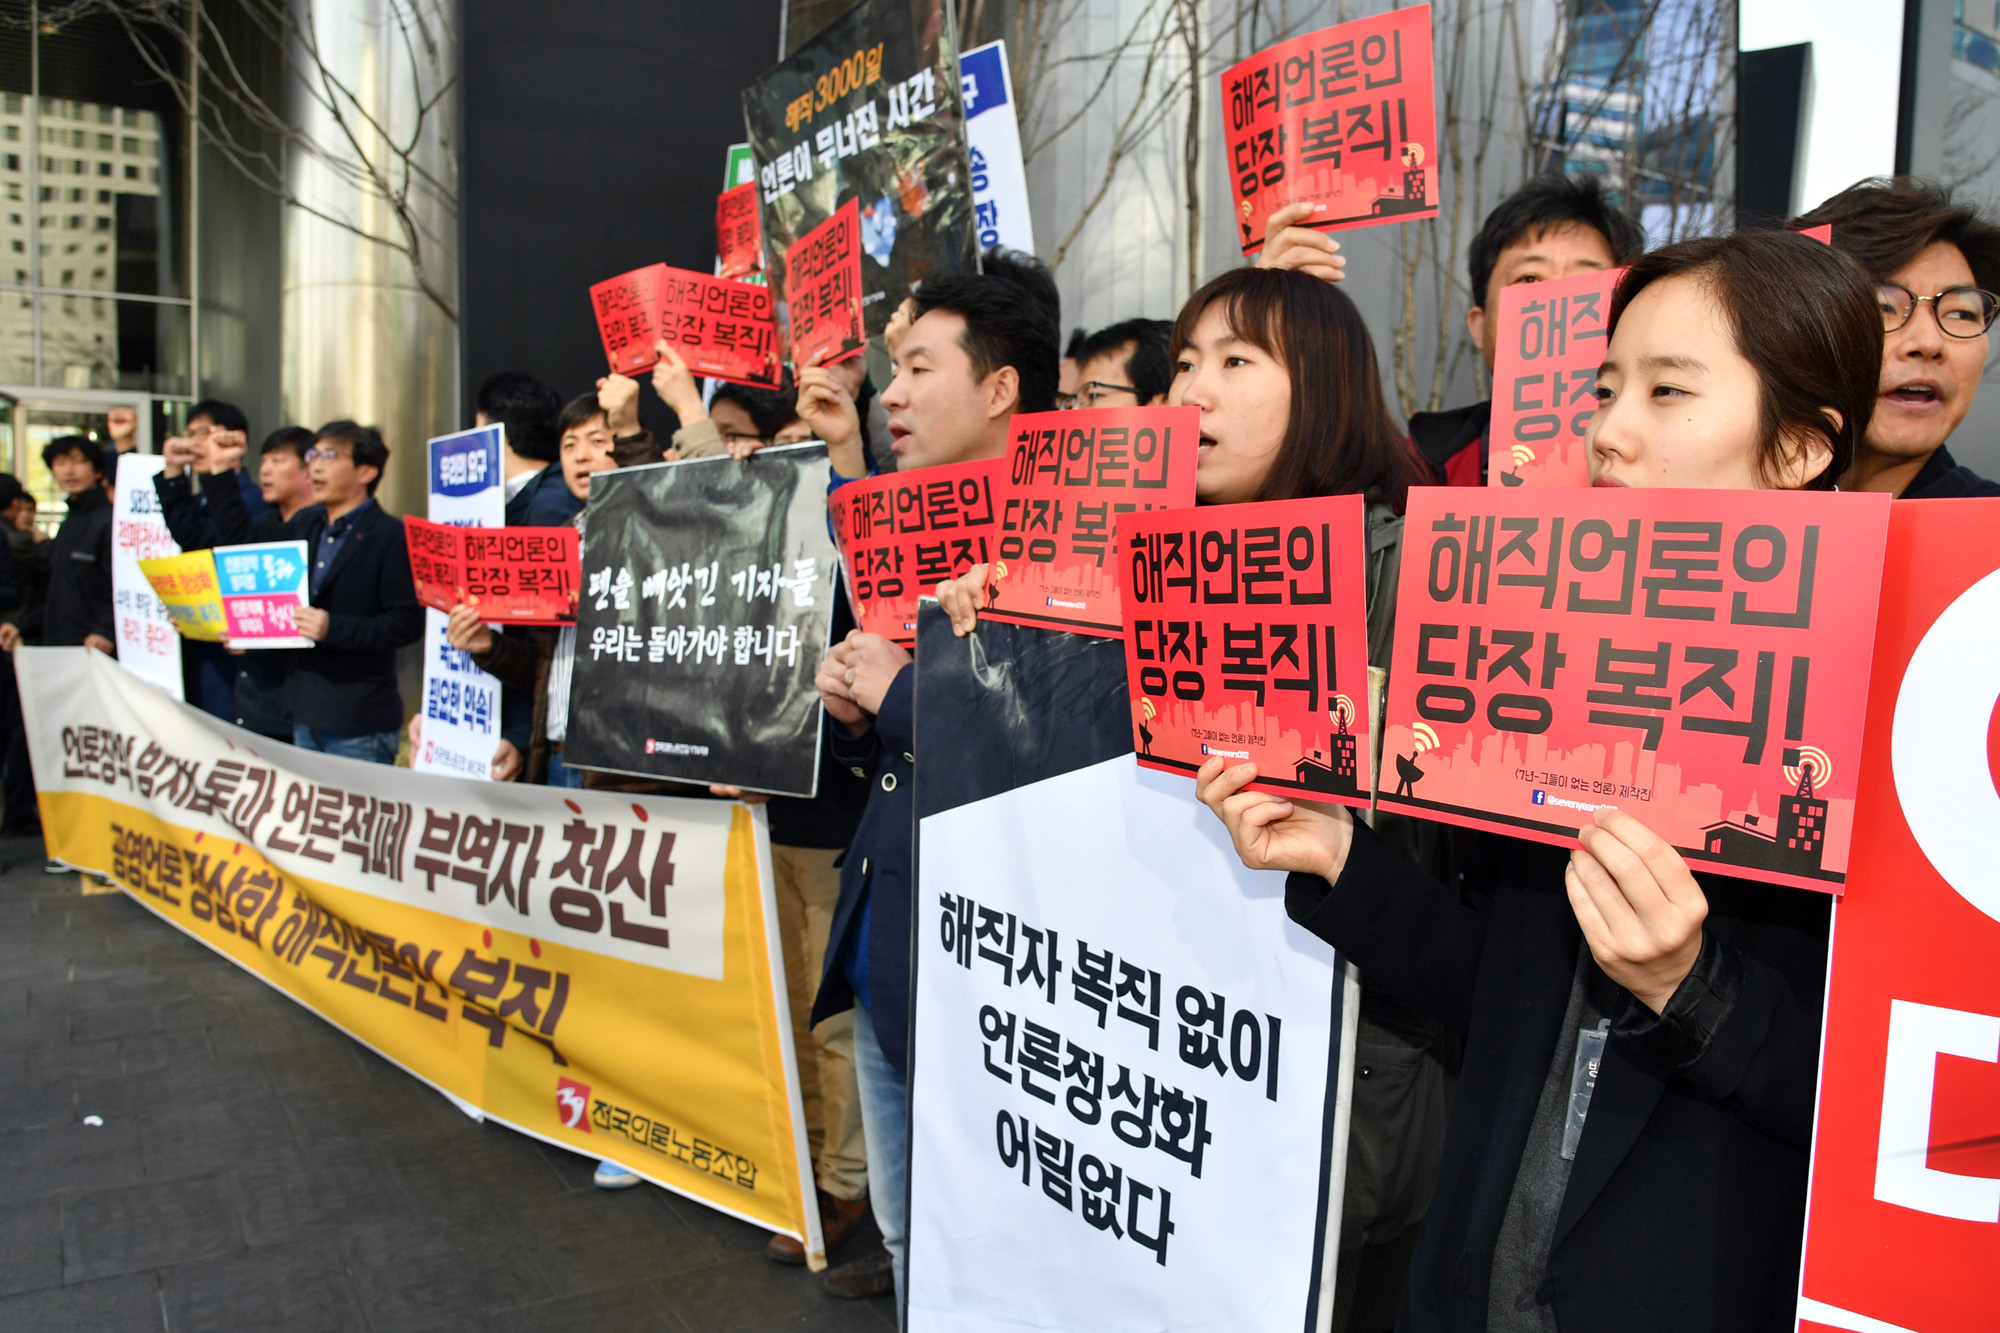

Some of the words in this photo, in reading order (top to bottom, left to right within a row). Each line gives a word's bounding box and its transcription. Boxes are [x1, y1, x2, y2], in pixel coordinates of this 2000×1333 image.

[815, 42, 883, 112] 3000일
[1230, 29, 1403, 131] 해직언론인
[761, 140, 813, 205] 언론이
[815, 99, 880, 170] 무너진
[886, 66, 936, 132] 시간
[1234, 125, 1287, 197] 당장
[1300, 98, 1408, 169] 복직!
[791, 215, 849, 293] 해직언론인
[661, 311, 706, 345] 당장
[713, 321, 772, 358] 복직!
[666, 278, 773, 322] 해직언론인
[793, 288, 815, 342] 당장
[1011, 427, 1171, 489] 해직언론인
[852, 475, 994, 540] 해직언론인
[1000, 498, 1063, 562] 당장
[465, 536, 566, 562] 해직언론인
[467, 568, 510, 596] 당장
[519, 568, 570, 596] 복직!
[642, 561, 719, 610] 빼앗긴
[731, 557, 818, 607] 기자들
[854, 545, 904, 600] 당장
[1130, 523, 1332, 605] 해직언론인
[1427, 512, 1820, 629] 해직언론인
[589, 625, 644, 663] 우리는
[648, 625, 728, 665] 돌아가야
[733, 625, 802, 668] 합니다
[1134, 619, 1207, 702] 당장
[1221, 622, 1338, 712] 복직!
[428, 677, 461, 726] 필요한
[464, 684, 493, 734] 약속!
[1416, 623, 1567, 735] 당장
[1586, 638, 1810, 767] 복직!
[1570, 777, 1590, 792] 없는
[1619, 785, 1651, 802] 제작진
[62, 725, 136, 791] 언론장악
[266, 781, 412, 882] 언론적폐
[414, 808, 543, 916] 부역자
[549, 818, 677, 949] 청산
[939, 891, 1062, 1004] 해직자
[1071, 939, 1161, 1052] 복직
[1175, 985, 1282, 1103] 없이
[979, 1004, 1213, 1179] 언론정상화
[592, 1099, 758, 1190] 전국언론노동조합
[996, 1108, 1175, 1267] 어림없다
